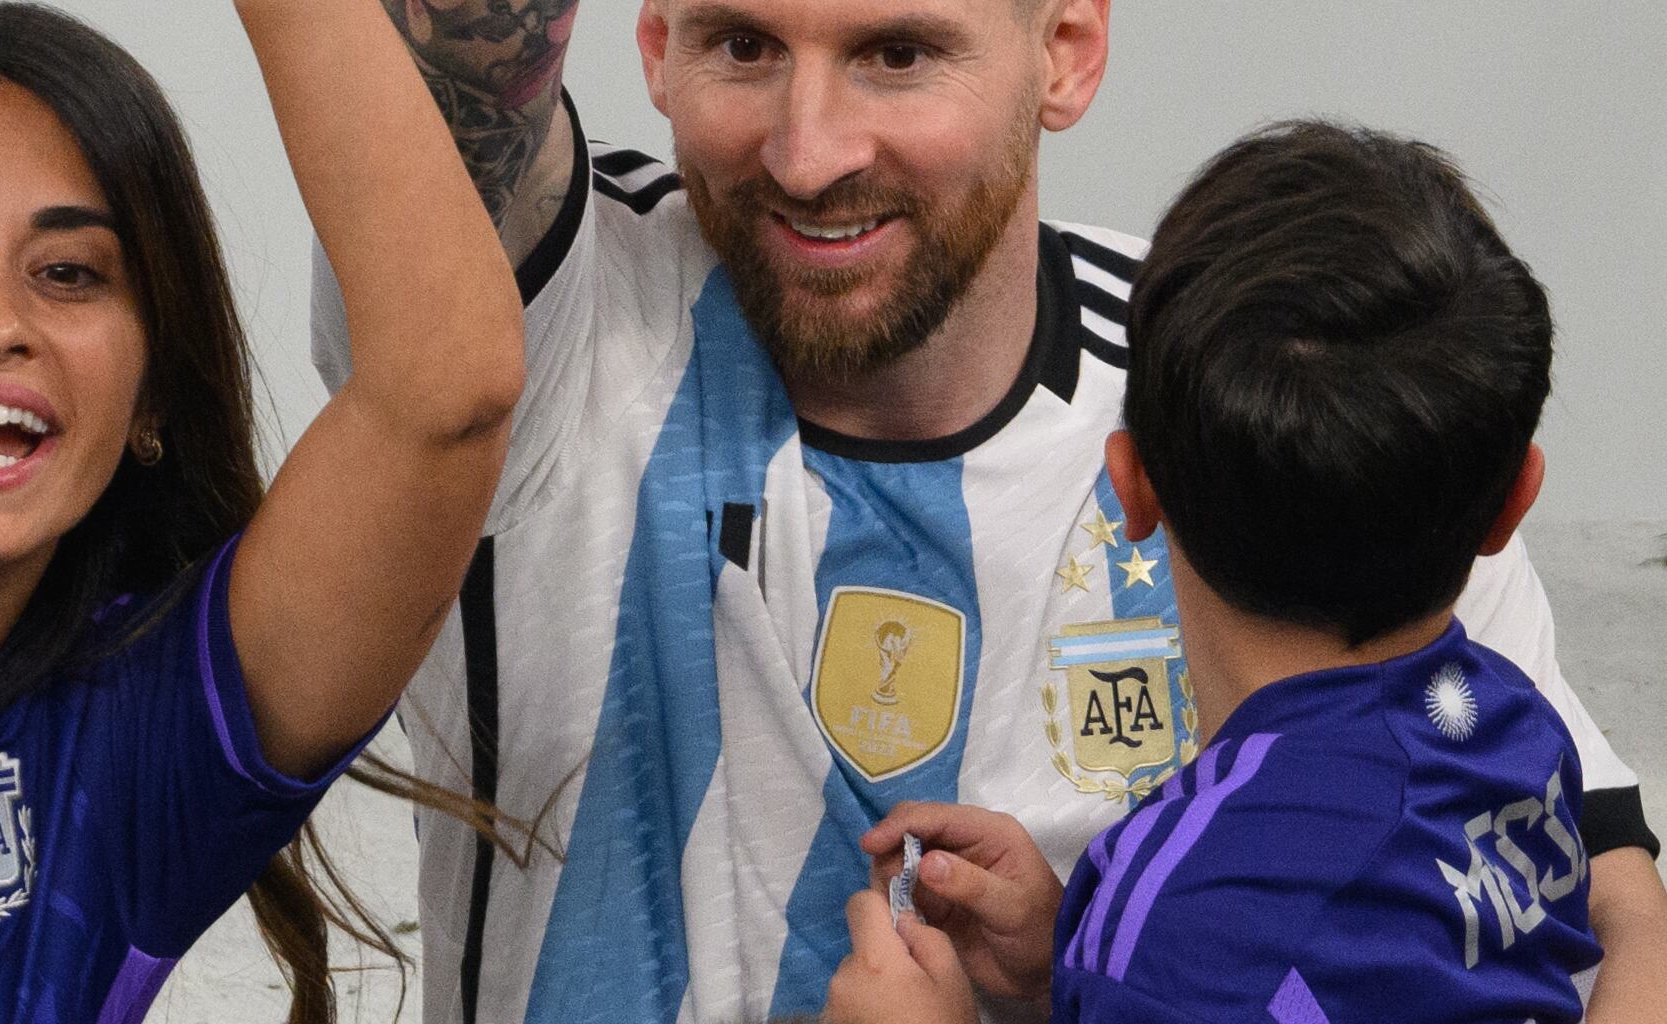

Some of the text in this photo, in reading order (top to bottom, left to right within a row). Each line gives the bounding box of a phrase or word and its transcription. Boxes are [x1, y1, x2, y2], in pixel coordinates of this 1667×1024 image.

[848, 705, 911, 737] FIFA
[1080, 666, 1164, 748] AFA
[1435, 752, 1587, 970] MESS
